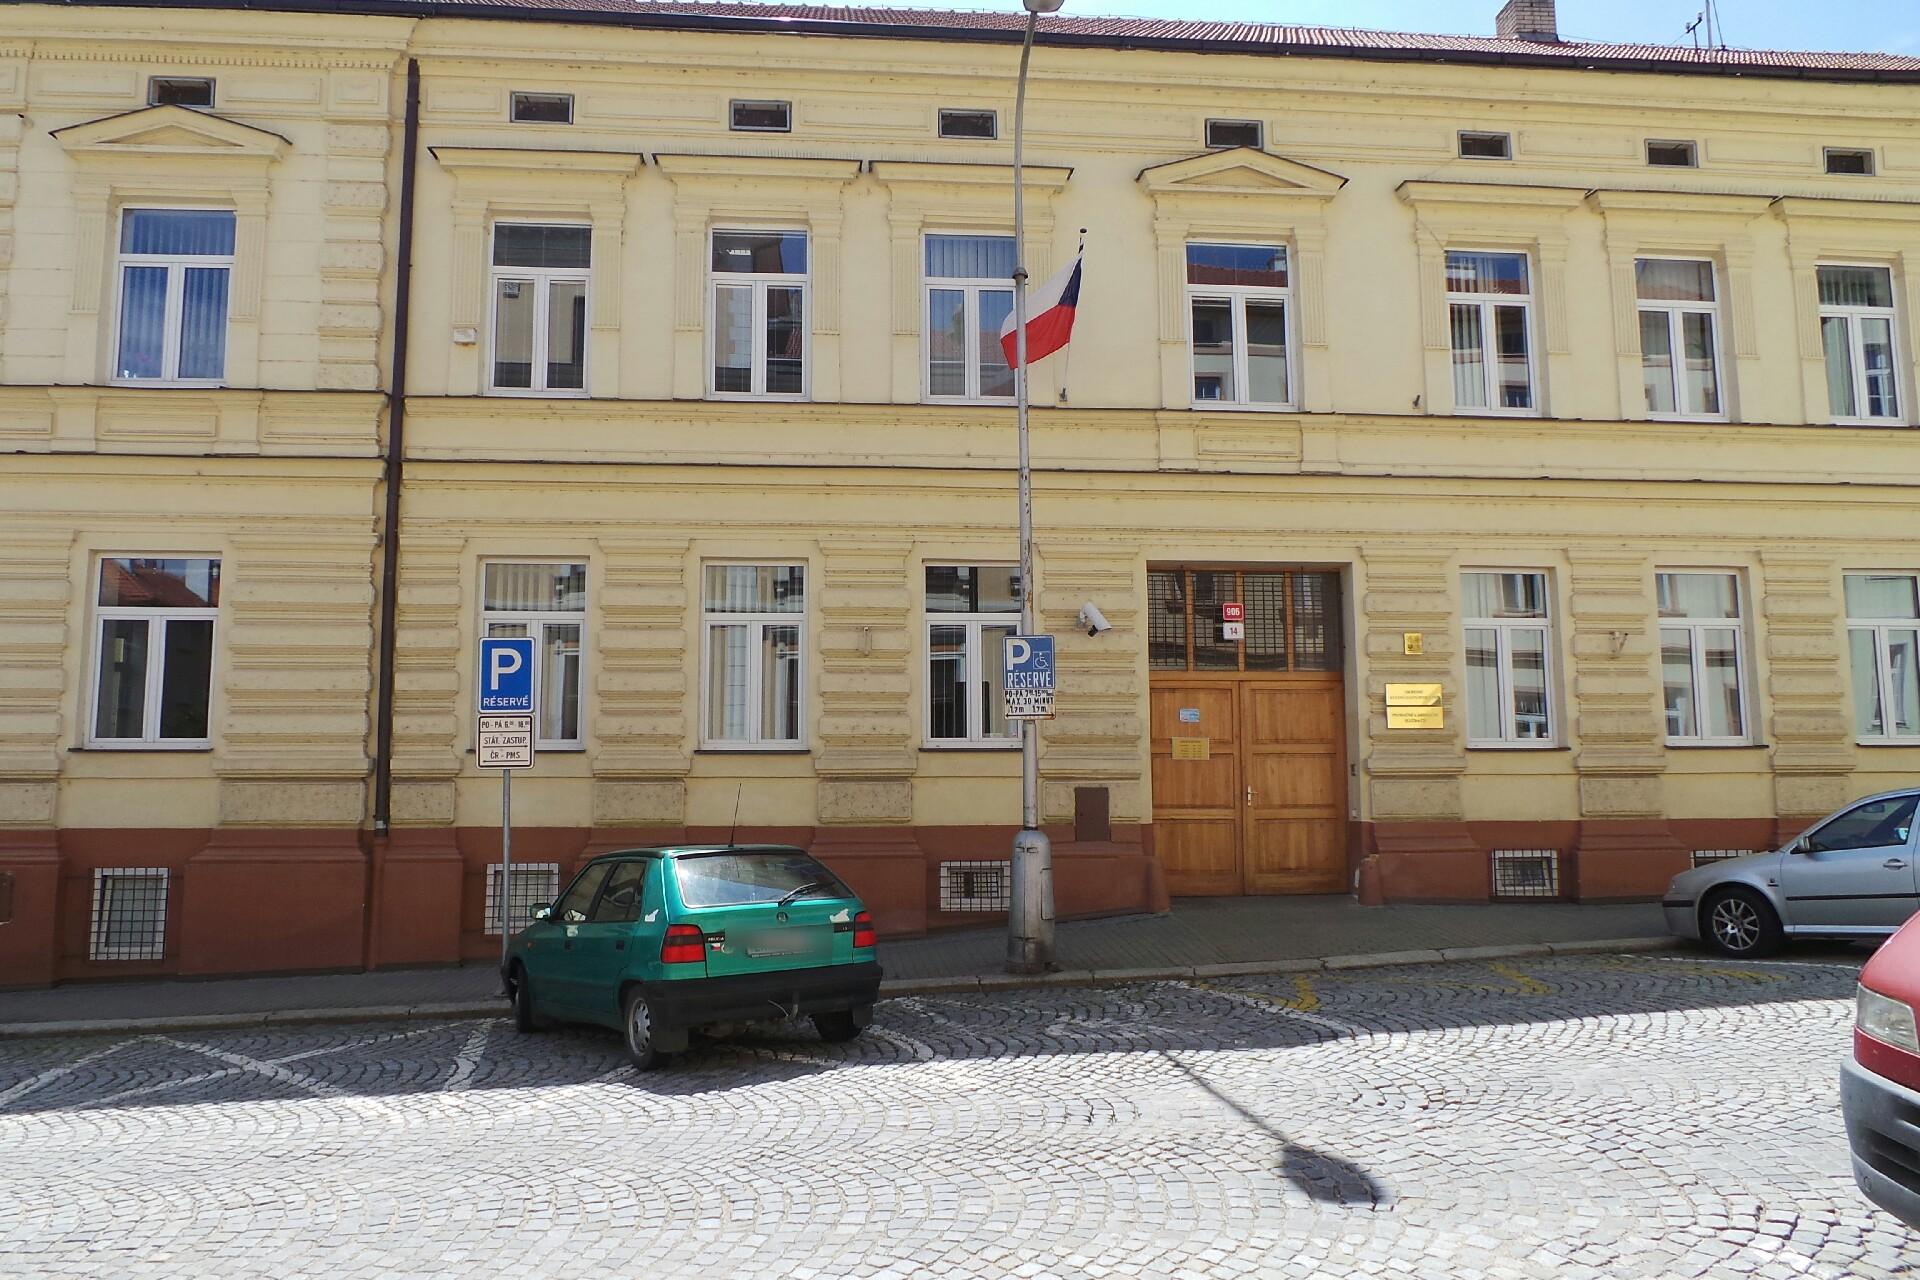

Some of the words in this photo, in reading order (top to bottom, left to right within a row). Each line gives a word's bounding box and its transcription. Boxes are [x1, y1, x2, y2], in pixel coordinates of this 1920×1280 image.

[1226, 607, 1241, 616] 906
[1230, 627, 1238, 636] 14
[1006, 638, 1031, 671] P
[490, 647, 523, 690] P
[1007, 670, 1052, 688] RÉSERVÉ
[483, 695, 529, 707] RÉSERVÉ
[1023, 697, 1032, 705] 30
[1034, 696, 1054, 705] MINUT
[505, 751, 521, 759] PMS
